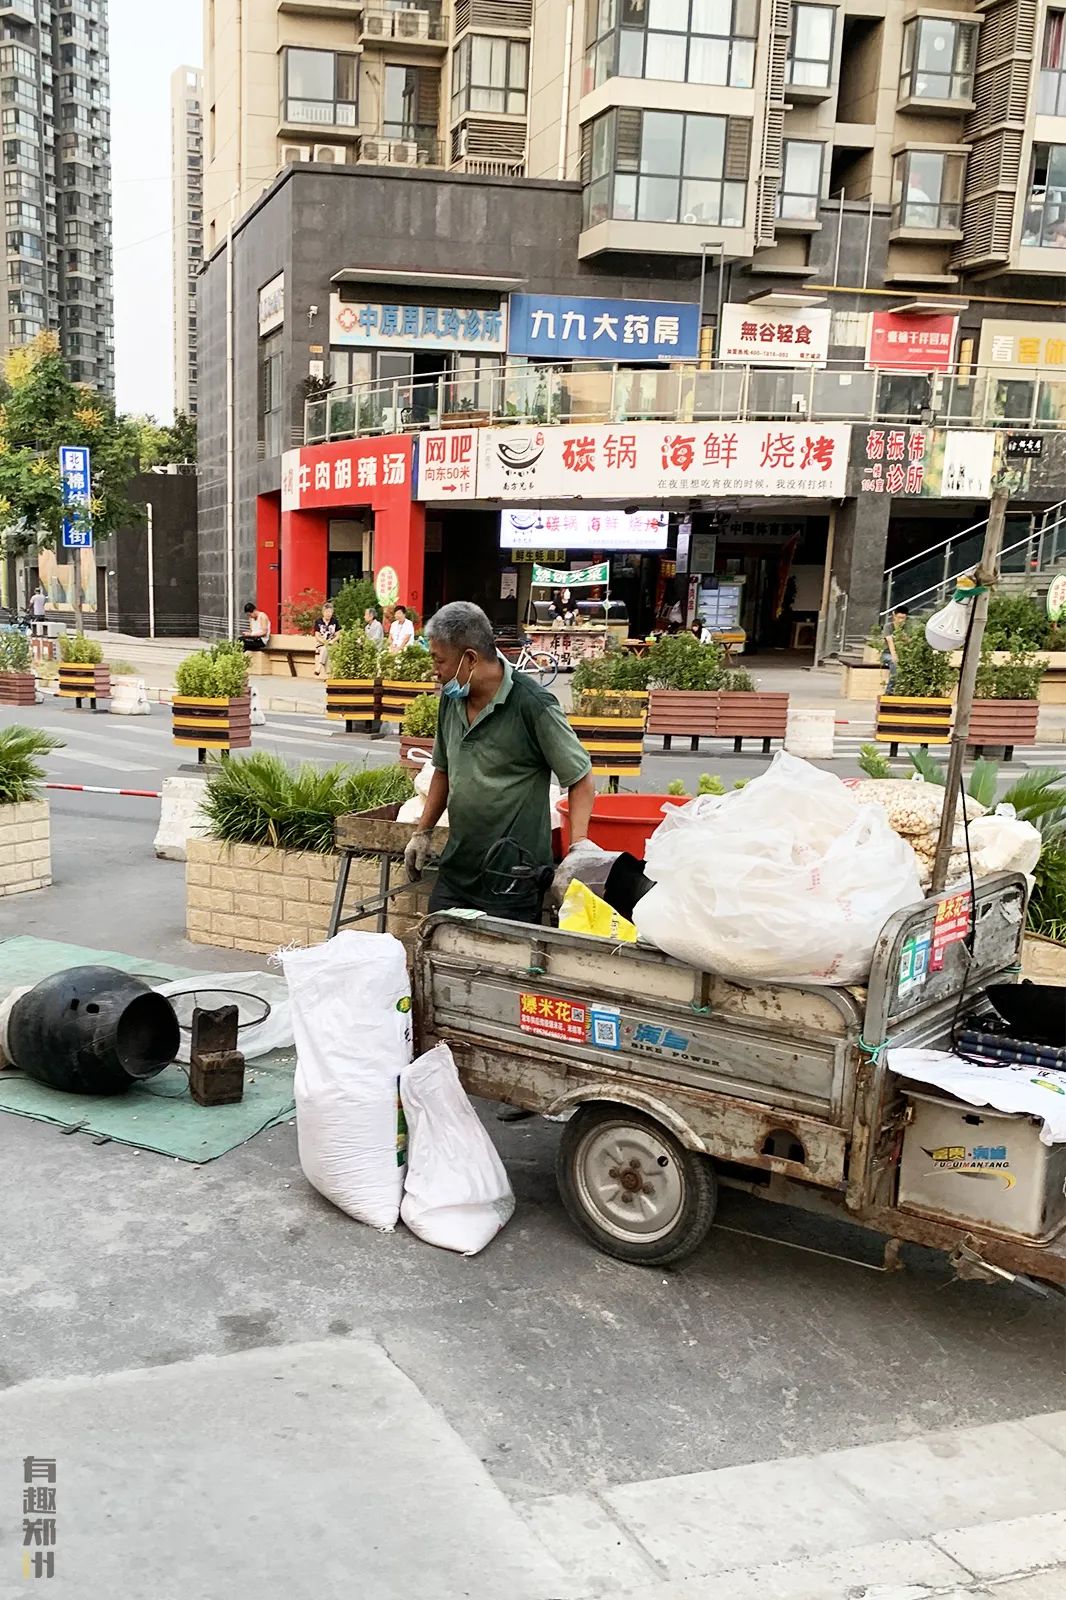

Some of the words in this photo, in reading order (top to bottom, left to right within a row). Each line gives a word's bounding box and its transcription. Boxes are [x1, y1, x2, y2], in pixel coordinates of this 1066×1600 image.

[531, 310, 680, 345] 九九大药房
[740, 321, 812, 345] 無谷轻食
[69, 453, 80, 466] 北
[425, 435, 472, 464] 网吧
[562, 434, 637, 472] 碳锅
[661, 432, 739, 472] 海鲜
[759, 432, 835, 472] 烧烤
[866, 429, 926, 461] 杨振伟
[299, 453, 405, 493] 牛肉胡辣汤
[425, 466, 470, 481] 向东50米
[459, 482, 470, 492] 1F
[885, 464, 925, 494] 诊所
[67, 473, 86, 545] 棉纺街
[521, 994, 572, 1022] 爆米花
[631, 1042, 663, 1054] BIKE
[672, 1051, 720, 1067] POWER
